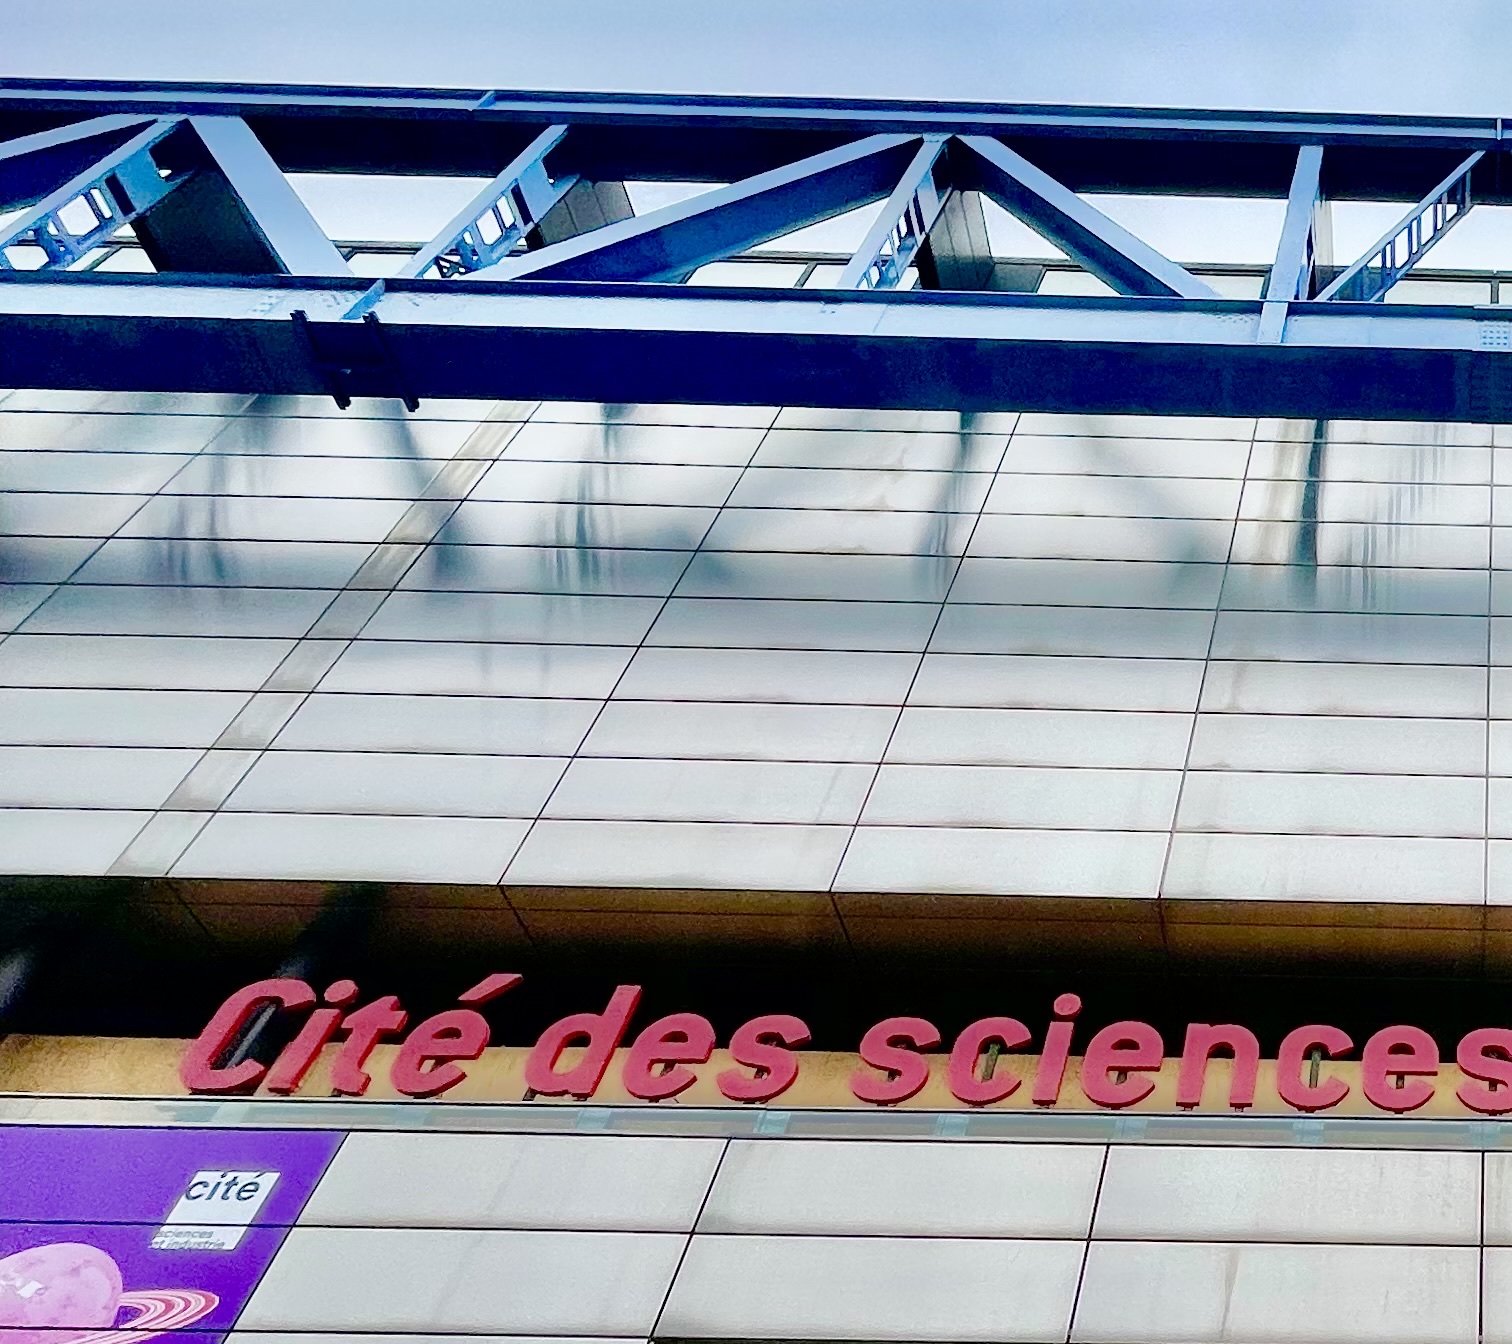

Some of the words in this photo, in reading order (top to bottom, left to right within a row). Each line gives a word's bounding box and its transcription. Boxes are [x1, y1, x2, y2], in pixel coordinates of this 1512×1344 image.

[178, 973, 524, 1098] Cité
[525, 985, 811, 1103] des
[185, 1171, 266, 1201] cité
